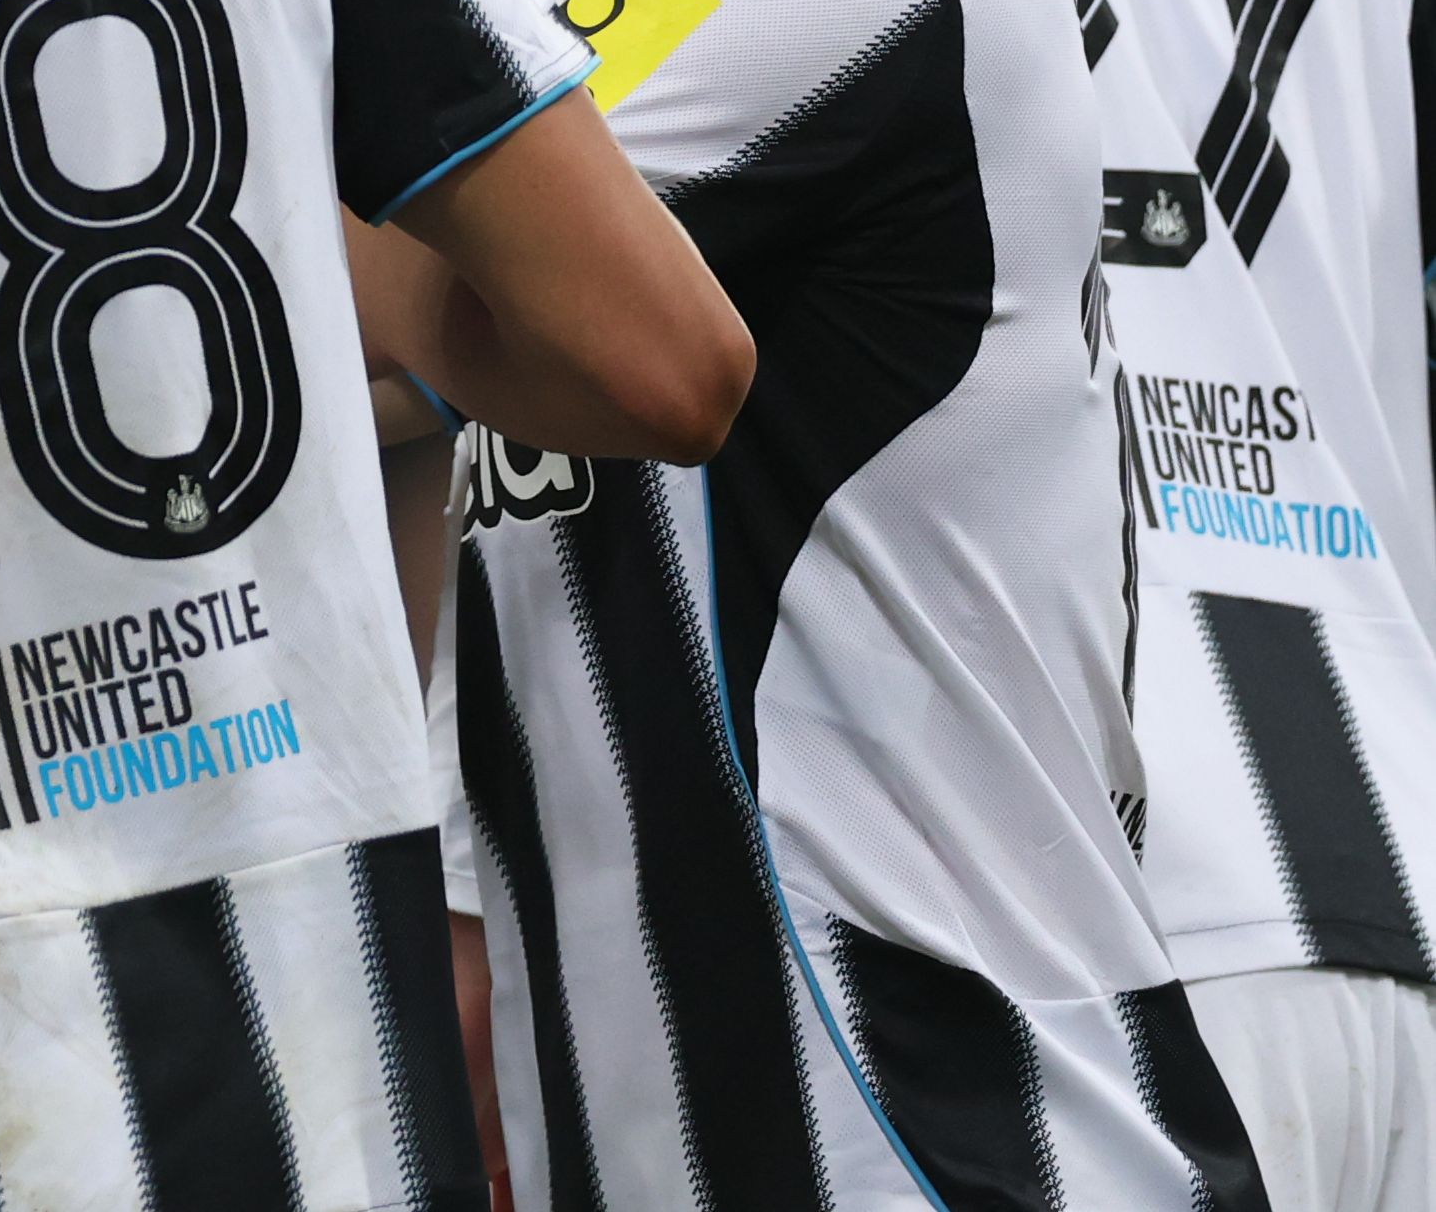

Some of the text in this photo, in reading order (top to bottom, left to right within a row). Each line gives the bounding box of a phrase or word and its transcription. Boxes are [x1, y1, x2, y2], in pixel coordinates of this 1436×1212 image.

[1148, 429, 1275, 496] UNITED
[1159, 483, 1378, 559] FOUNDATION
[10, 580, 269, 702] NEWCASTLE
[23, 667, 193, 760] UNITED
[38, 699, 301, 819] FOUNDATION
